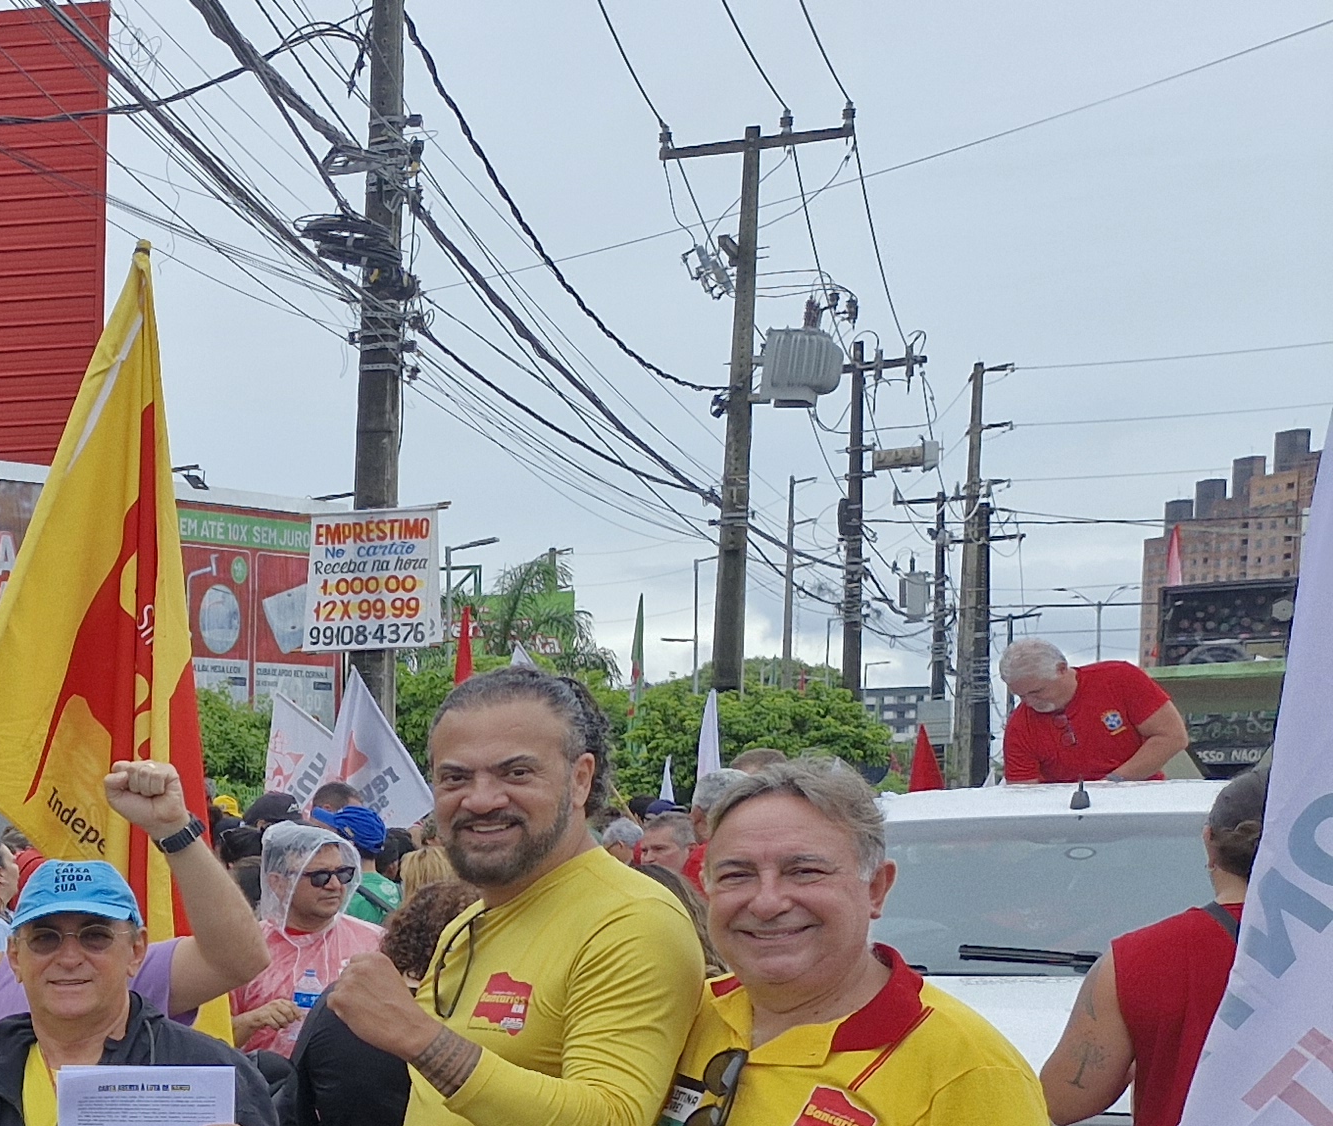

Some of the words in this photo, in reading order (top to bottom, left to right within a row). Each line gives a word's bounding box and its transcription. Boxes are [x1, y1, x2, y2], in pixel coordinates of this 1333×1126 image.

[200, 518, 226, 540] ATÉ
[252, 526, 278, 546] SEM
[324, 547, 346, 560] No
[356, 541, 416, 559] cartão
[313, 559, 368, 575] Receba
[371, 558, 391, 573] na
[393, 556, 429, 572] hora
[46, 786, 107, 855] Indepe
[54, 867, 90, 875] CAIXA
[54, 882, 77, 894] SUA
